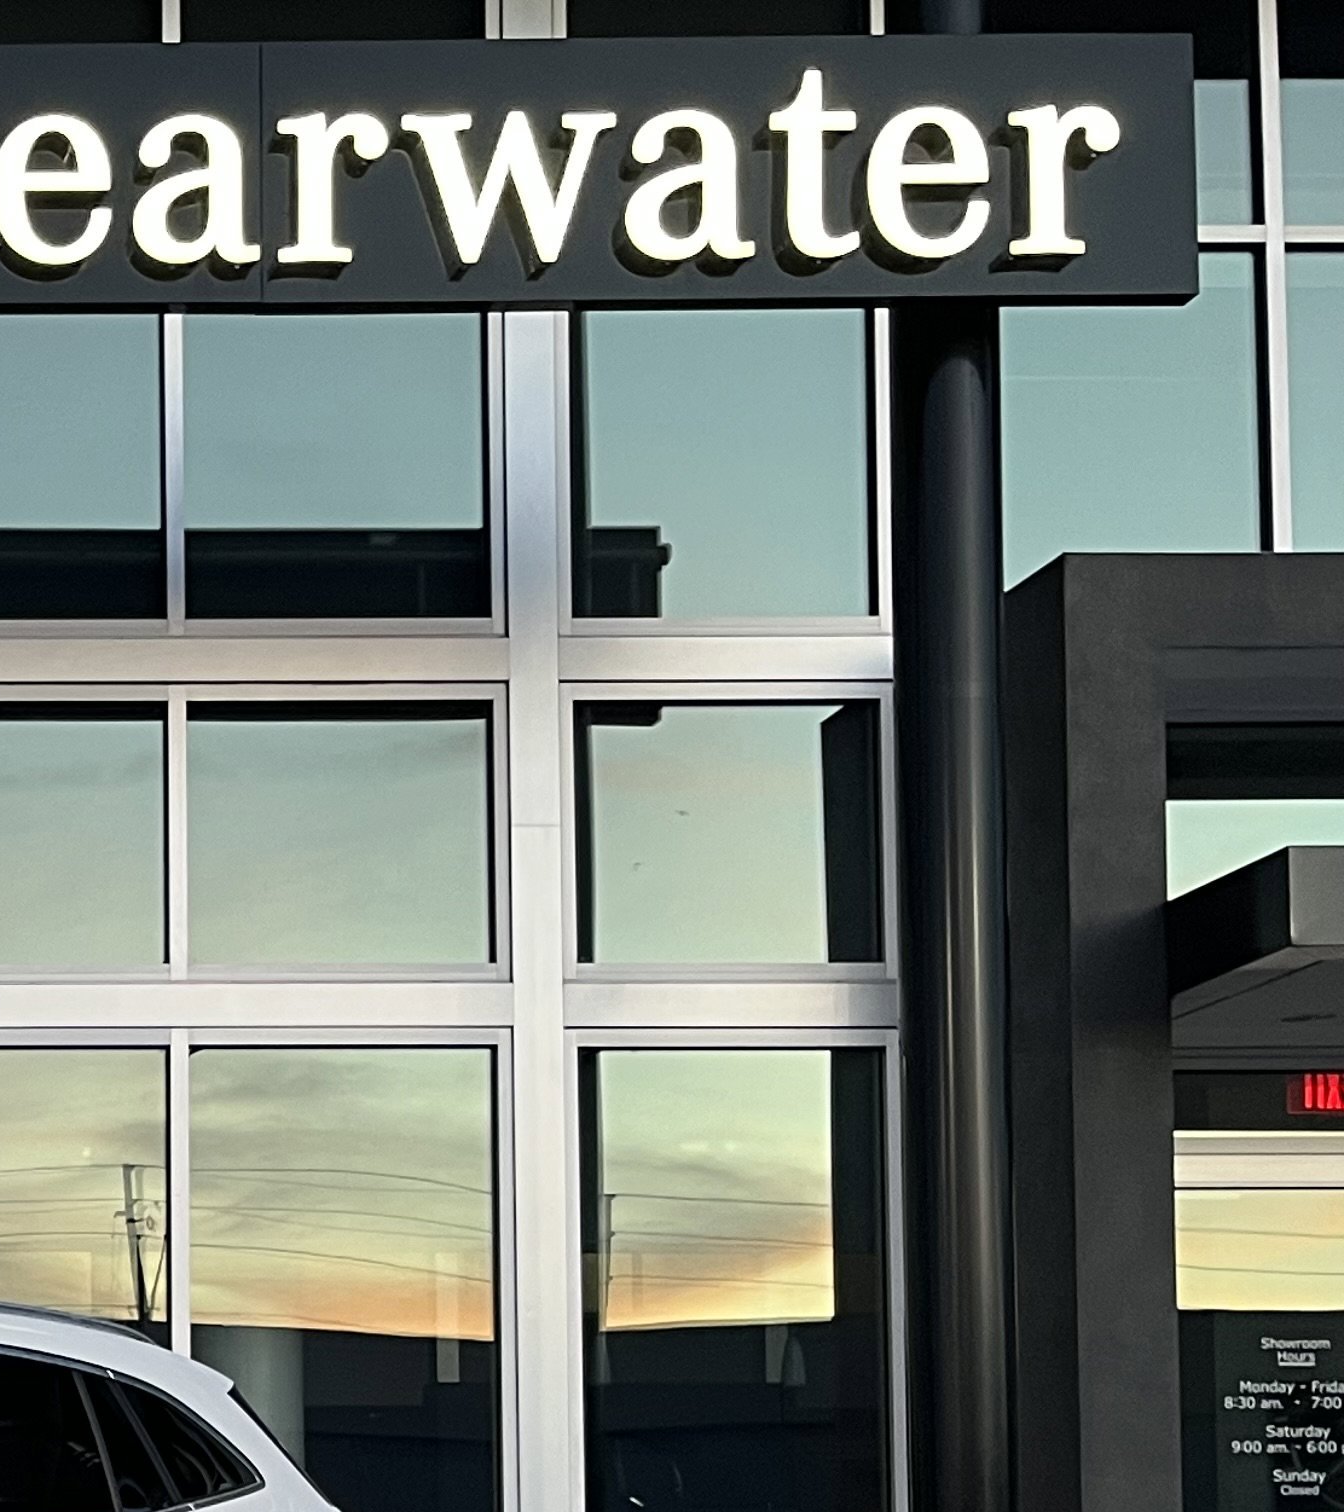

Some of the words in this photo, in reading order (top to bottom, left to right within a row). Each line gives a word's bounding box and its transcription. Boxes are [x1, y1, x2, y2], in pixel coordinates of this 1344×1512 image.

[1260, 1336, 1331, 1350] Showroom
[1276, 1350, 1316, 1364] Hours
[1239, 1380, 1295, 1396] Monday
[1223, 1395, 1257, 1410] 8:30
[1311, 1395, 1343, 1410] 7:00
[1265, 1424, 1331, 1440] Saturday
[1272, 1468, 1327, 1485] Sunday
[1280, 1484, 1320, 1496] Closed
